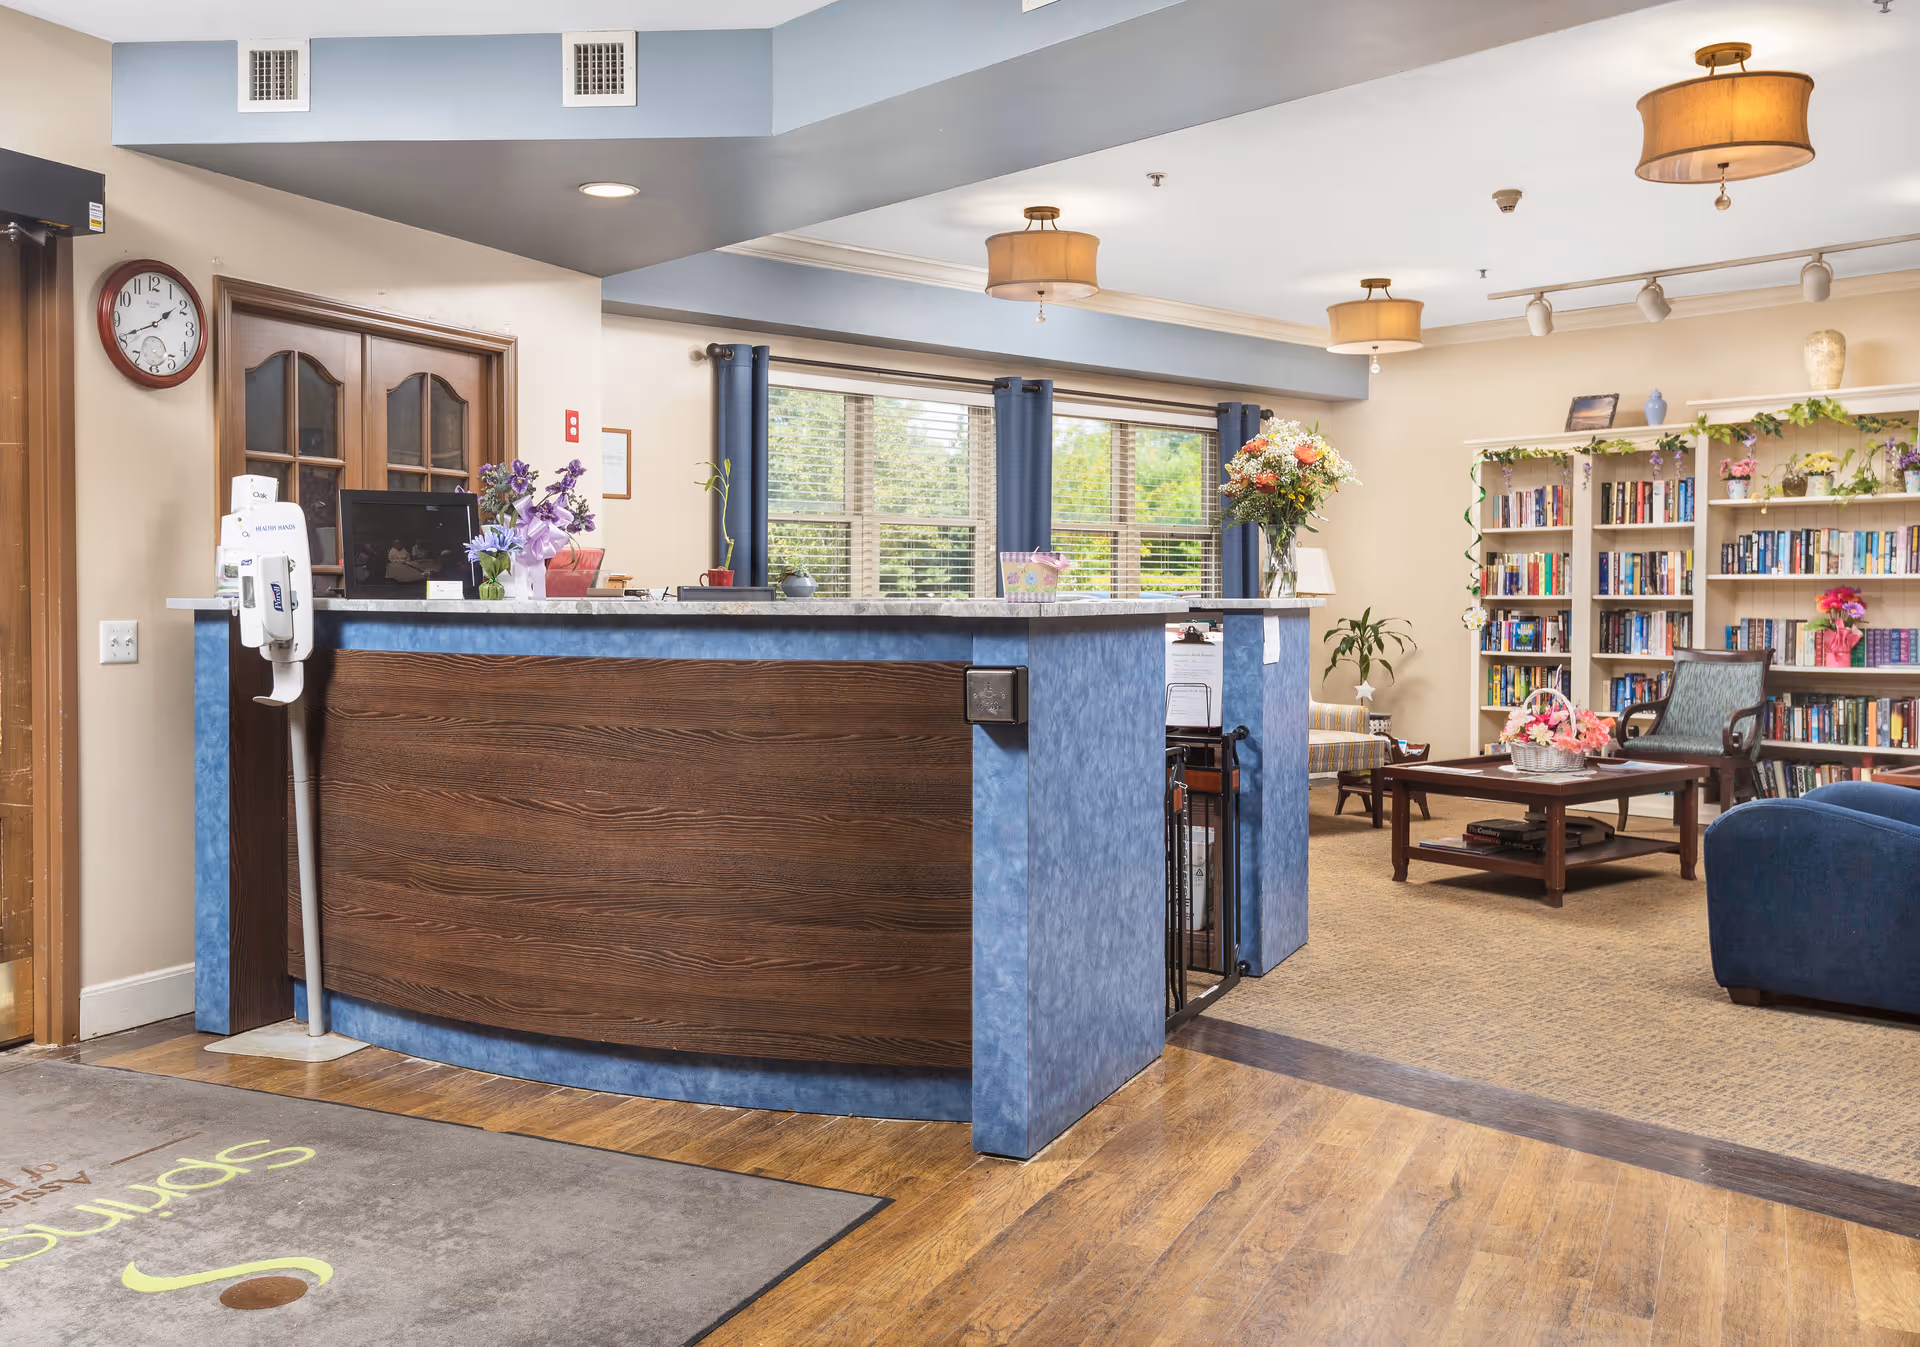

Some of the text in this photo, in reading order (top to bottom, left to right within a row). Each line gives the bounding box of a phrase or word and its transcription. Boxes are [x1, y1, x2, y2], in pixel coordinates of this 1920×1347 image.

[133, 278, 141, 295] 11
[148, 275, 161, 293] 12
[168, 283, 173, 300] 1
[119, 290, 132, 307] 10
[179, 300, 188, 316] 2
[113, 310, 121, 328] 9
[185, 321, 195, 338] 3
[118, 333, 128, 350] 8
[180, 341, 189, 357] 4
[132, 349, 141, 366] 7
[167, 353, 177, 371] 5
[252, 491, 268, 500] Oak
[1478, 827, 1501, 838] Century
[0, 1169, 92, 1214] Assis
